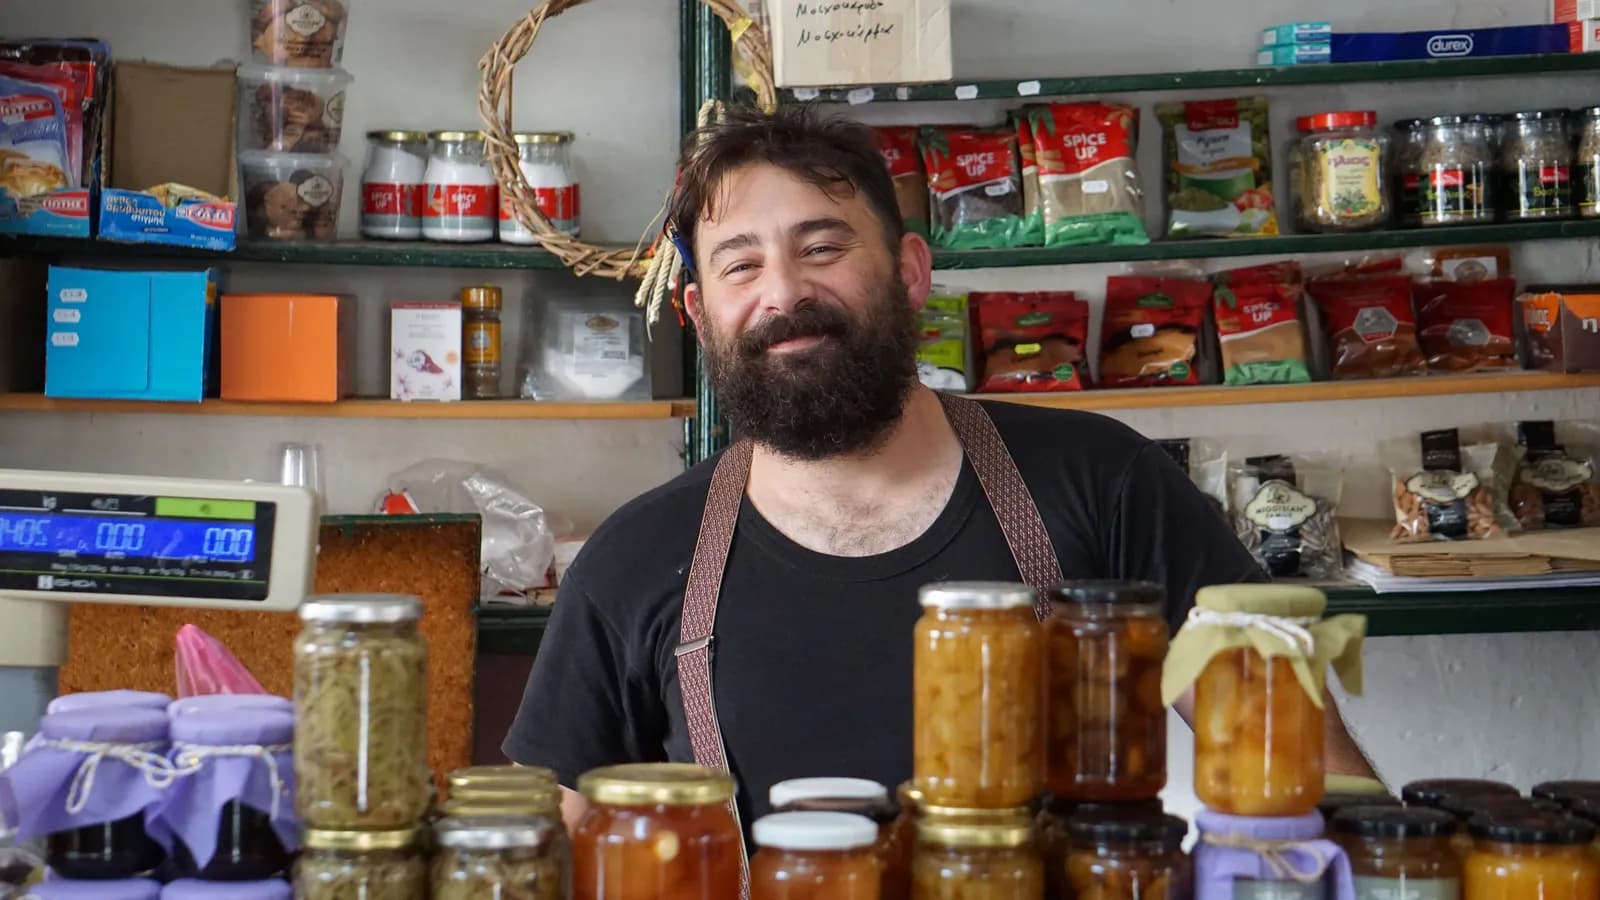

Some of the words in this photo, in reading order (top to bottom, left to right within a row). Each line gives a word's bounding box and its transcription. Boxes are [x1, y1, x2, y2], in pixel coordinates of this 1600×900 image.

[1430, 37, 1470, 52] durex
[1063, 132, 1107, 147] SPICE
[957, 151, 995, 167] SPICE
[1075, 147, 1097, 160] UP
[967, 163, 986, 176] UP
[450, 192, 476, 202] SPICE
[375, 200, 387, 209] UP
[1252, 312, 1273, 322] UP
